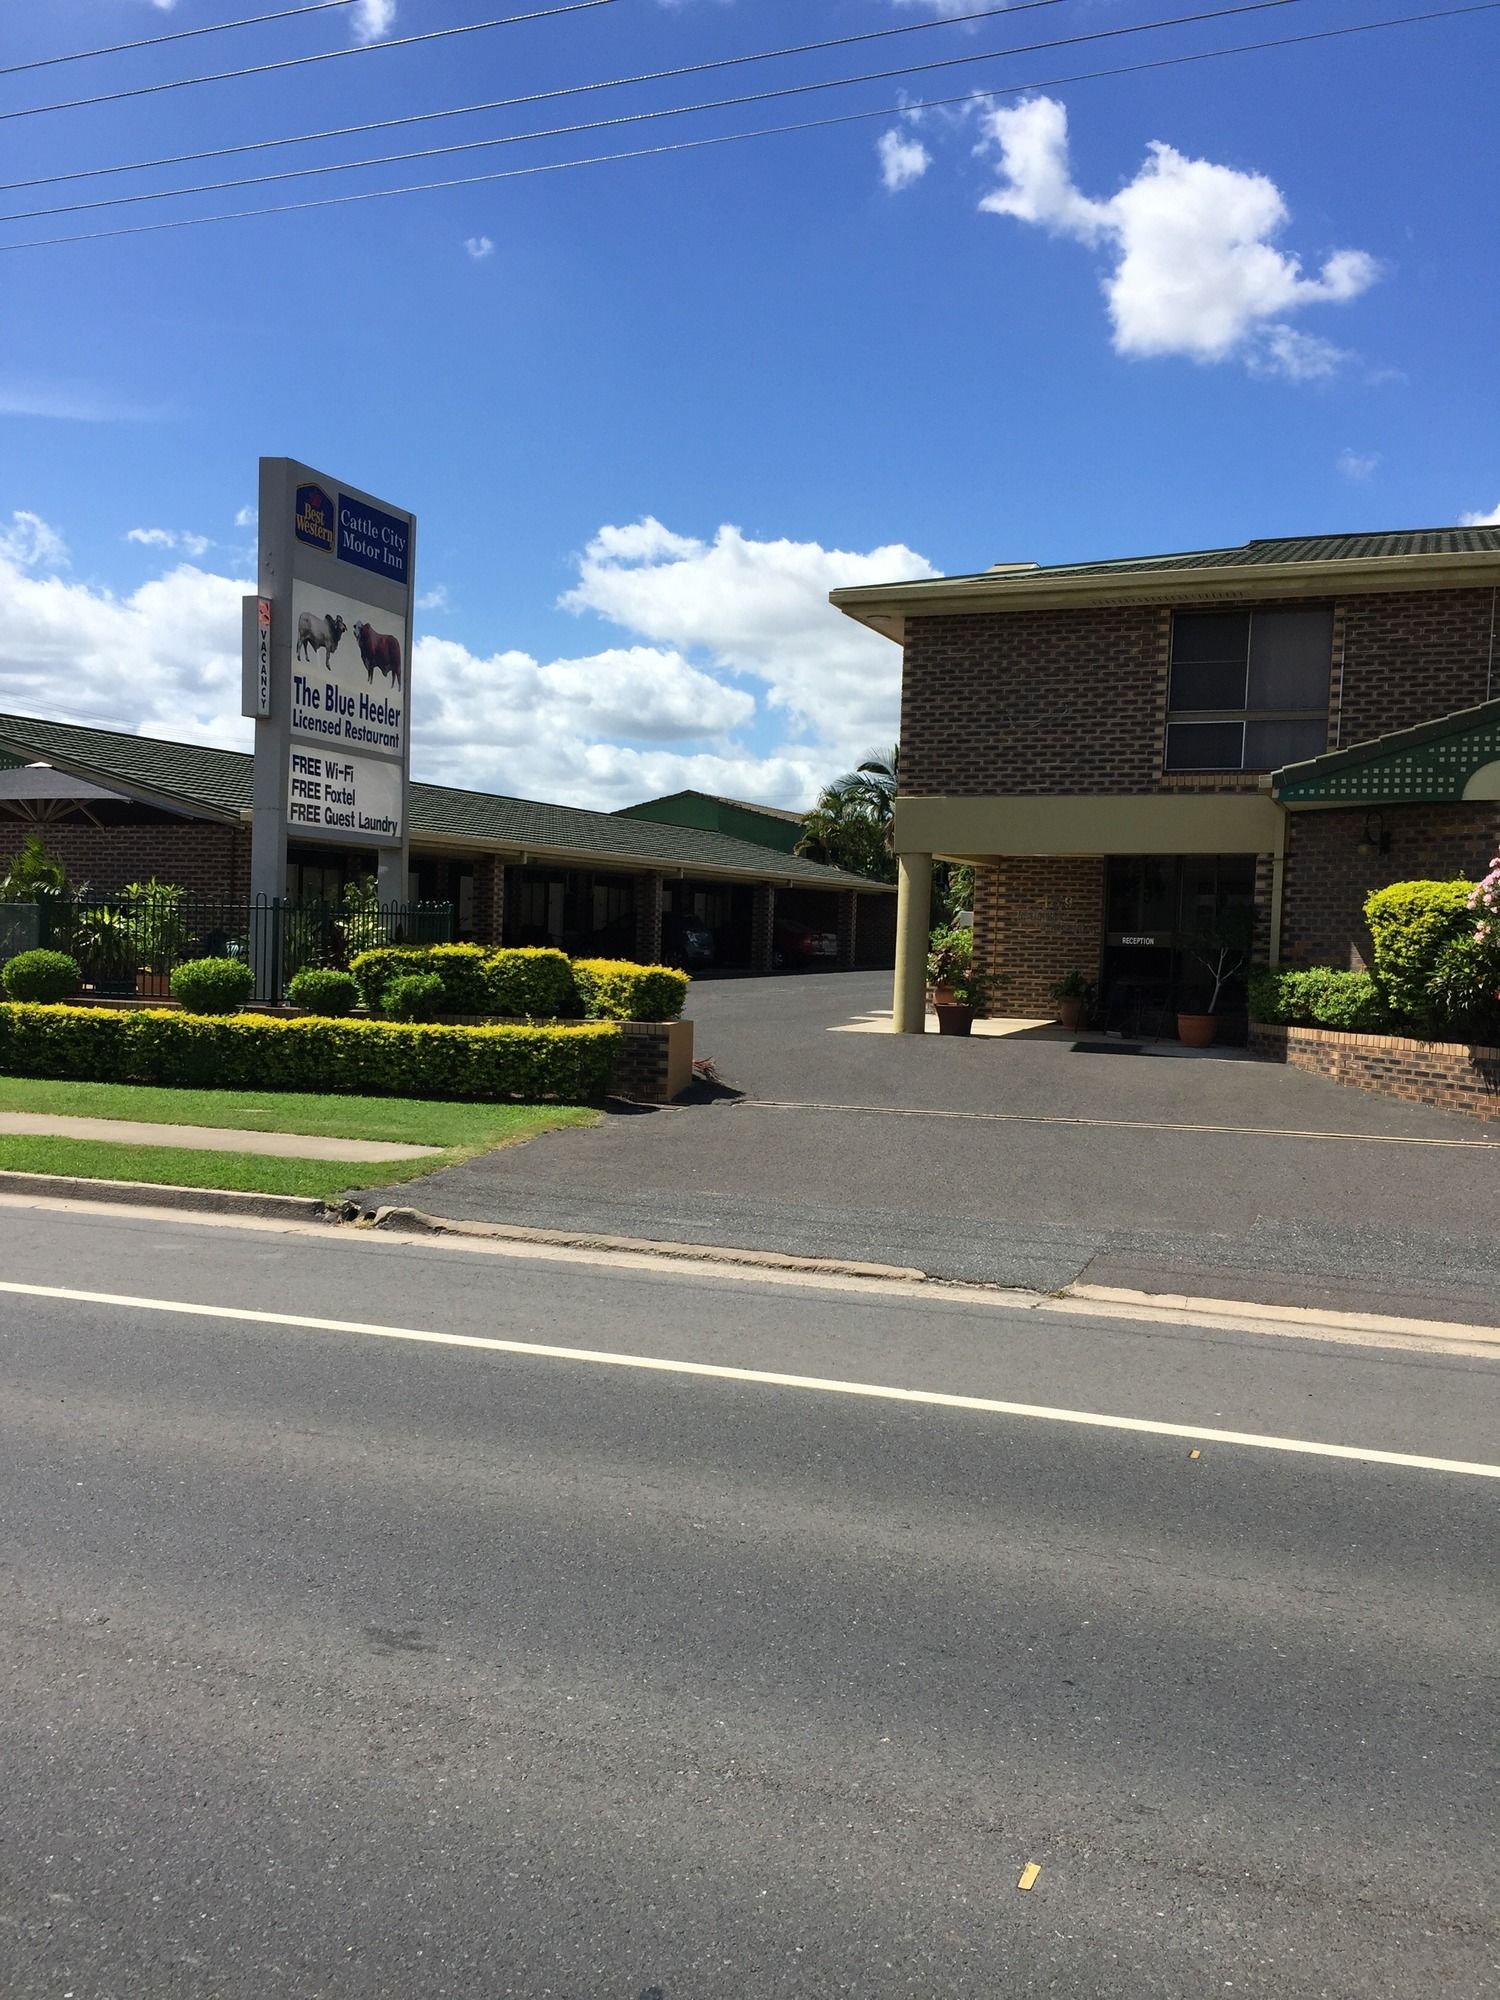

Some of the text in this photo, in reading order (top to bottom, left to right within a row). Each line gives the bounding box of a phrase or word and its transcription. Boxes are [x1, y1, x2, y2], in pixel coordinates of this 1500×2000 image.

[296, 513, 333, 543] Western
[304, 502, 325, 526] Best
[341, 509, 406, 552] Cattle City
[343, 531, 403, 569] Motor Inn
[293, 675, 401, 728] The Blue Heeler
[293, 708, 400, 748] Licensed Restaurant
[292, 754, 354, 783] FREE Wi-Fi
[291, 778, 356, 806] FREE Foxtel
[290, 802, 398, 837] FREE Guest Laundry
[1122, 937, 1154, 945] RECEPTION
